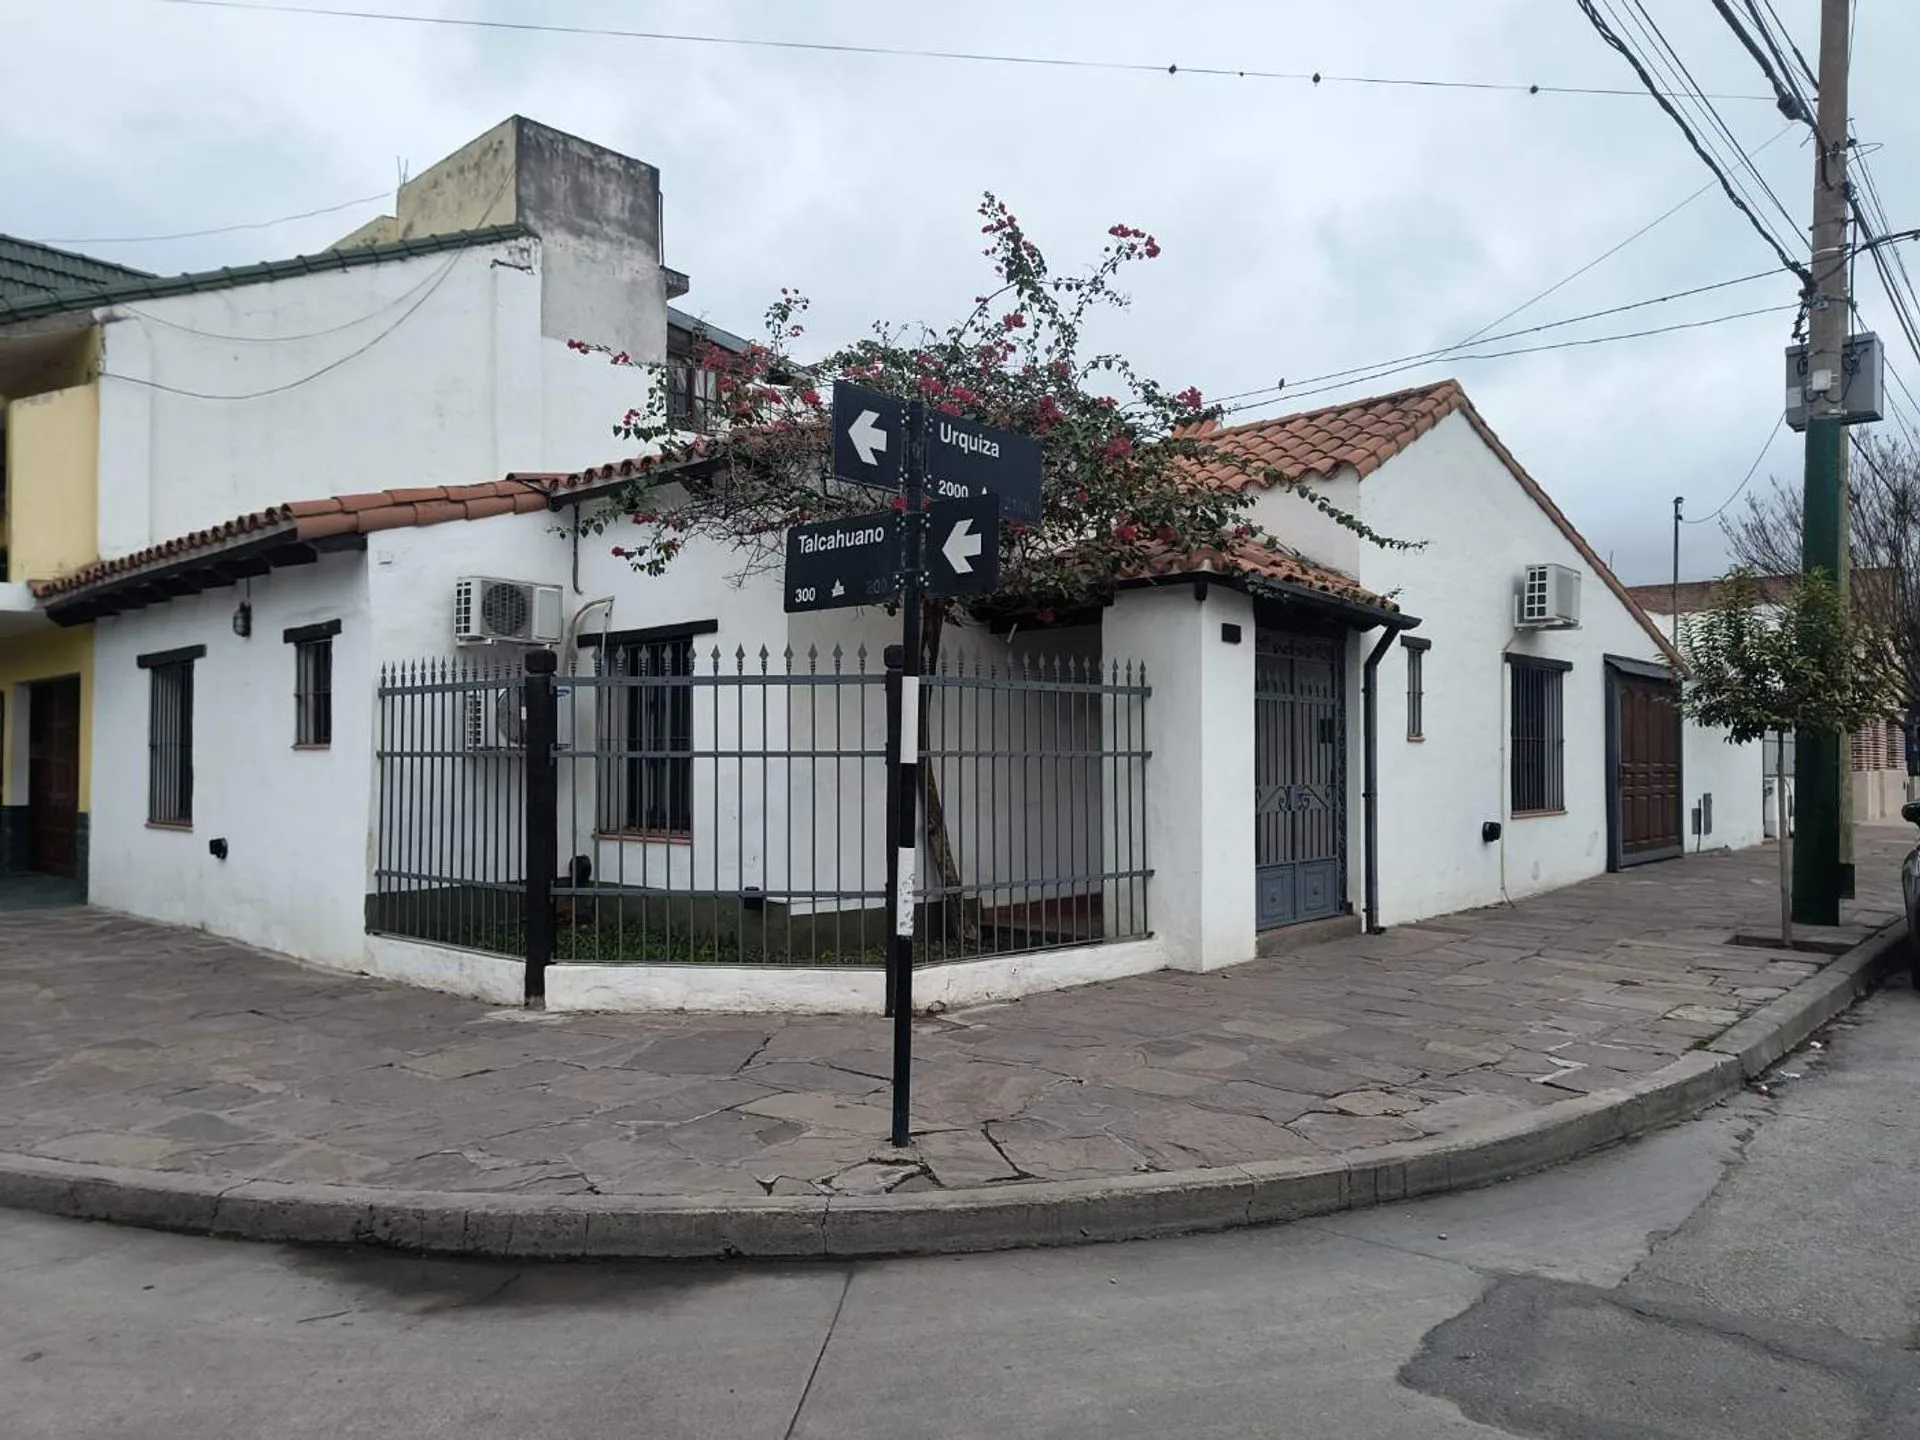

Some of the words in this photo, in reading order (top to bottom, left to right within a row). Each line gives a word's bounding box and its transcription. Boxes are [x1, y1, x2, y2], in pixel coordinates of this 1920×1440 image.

[939, 421, 1000, 459] Urquiza
[938, 479, 969, 499] 2000
[798, 525, 885, 554] Talcahuano
[795, 587, 816, 603] 300
